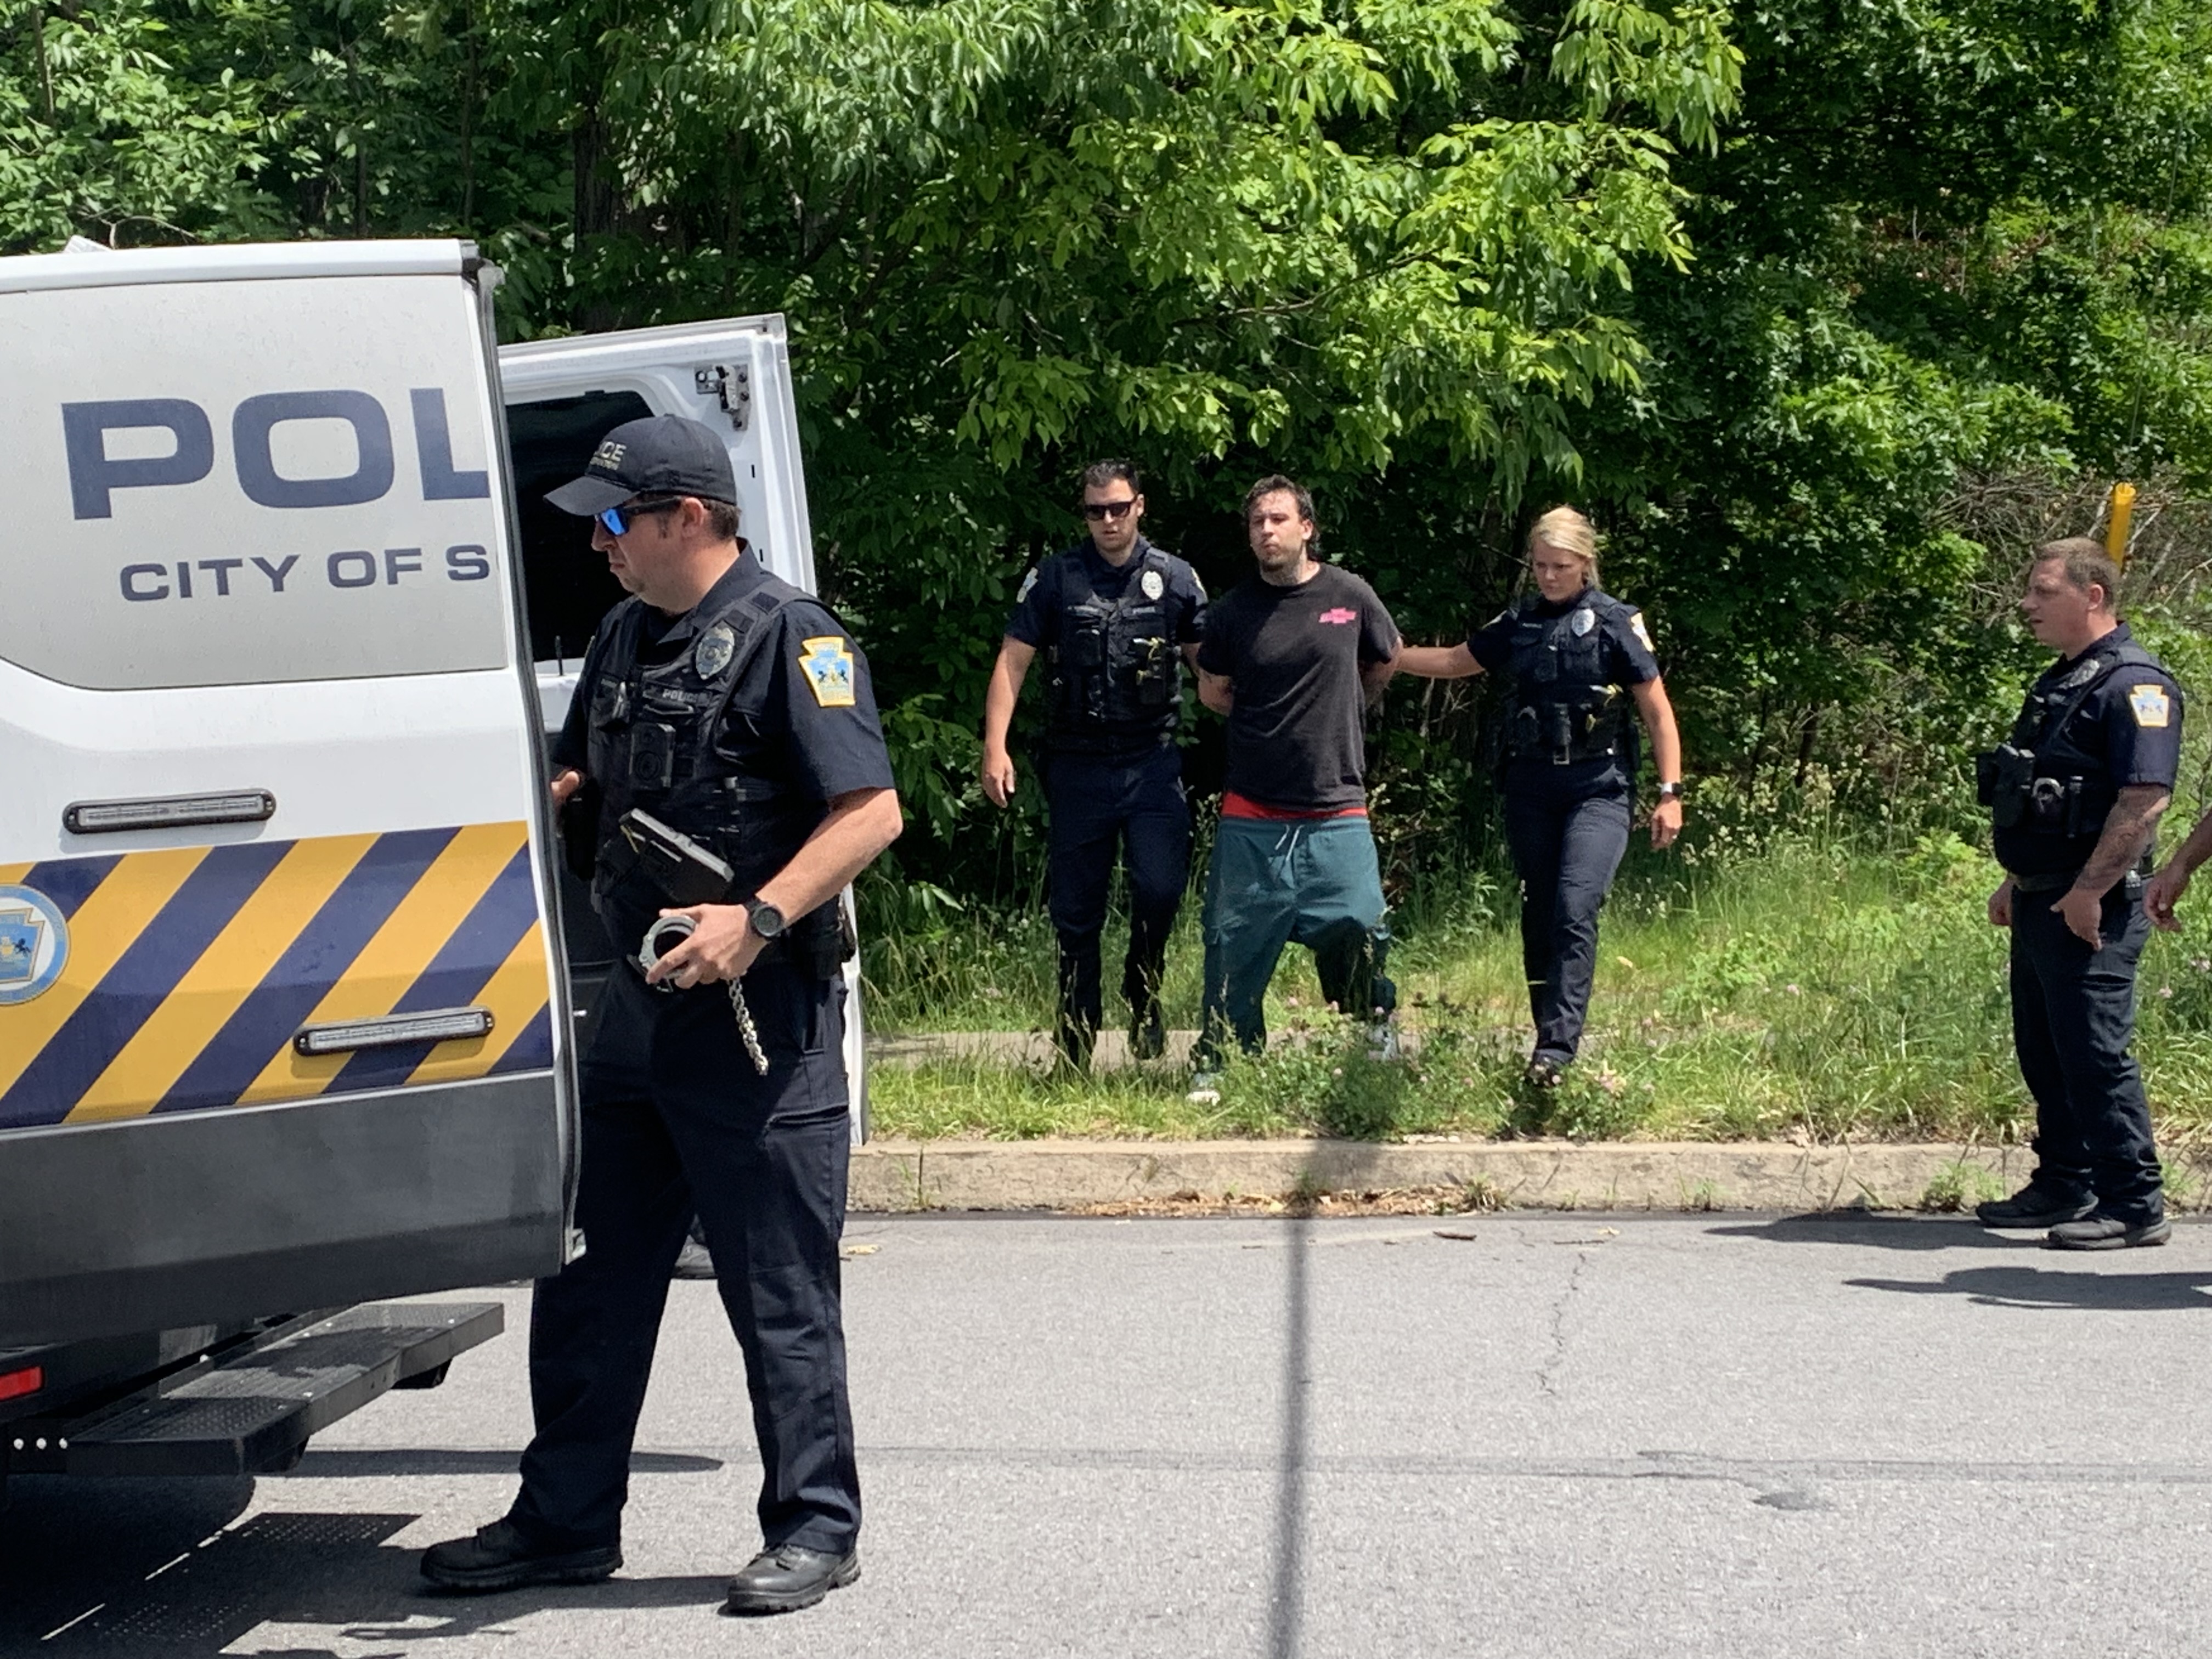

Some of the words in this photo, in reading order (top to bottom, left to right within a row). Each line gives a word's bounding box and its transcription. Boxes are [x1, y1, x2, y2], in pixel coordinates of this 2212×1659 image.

[61, 387, 491, 520] POL
[120, 555, 300, 601] CITY
[328, 548, 422, 588] OF
[445, 544, 490, 580] S
